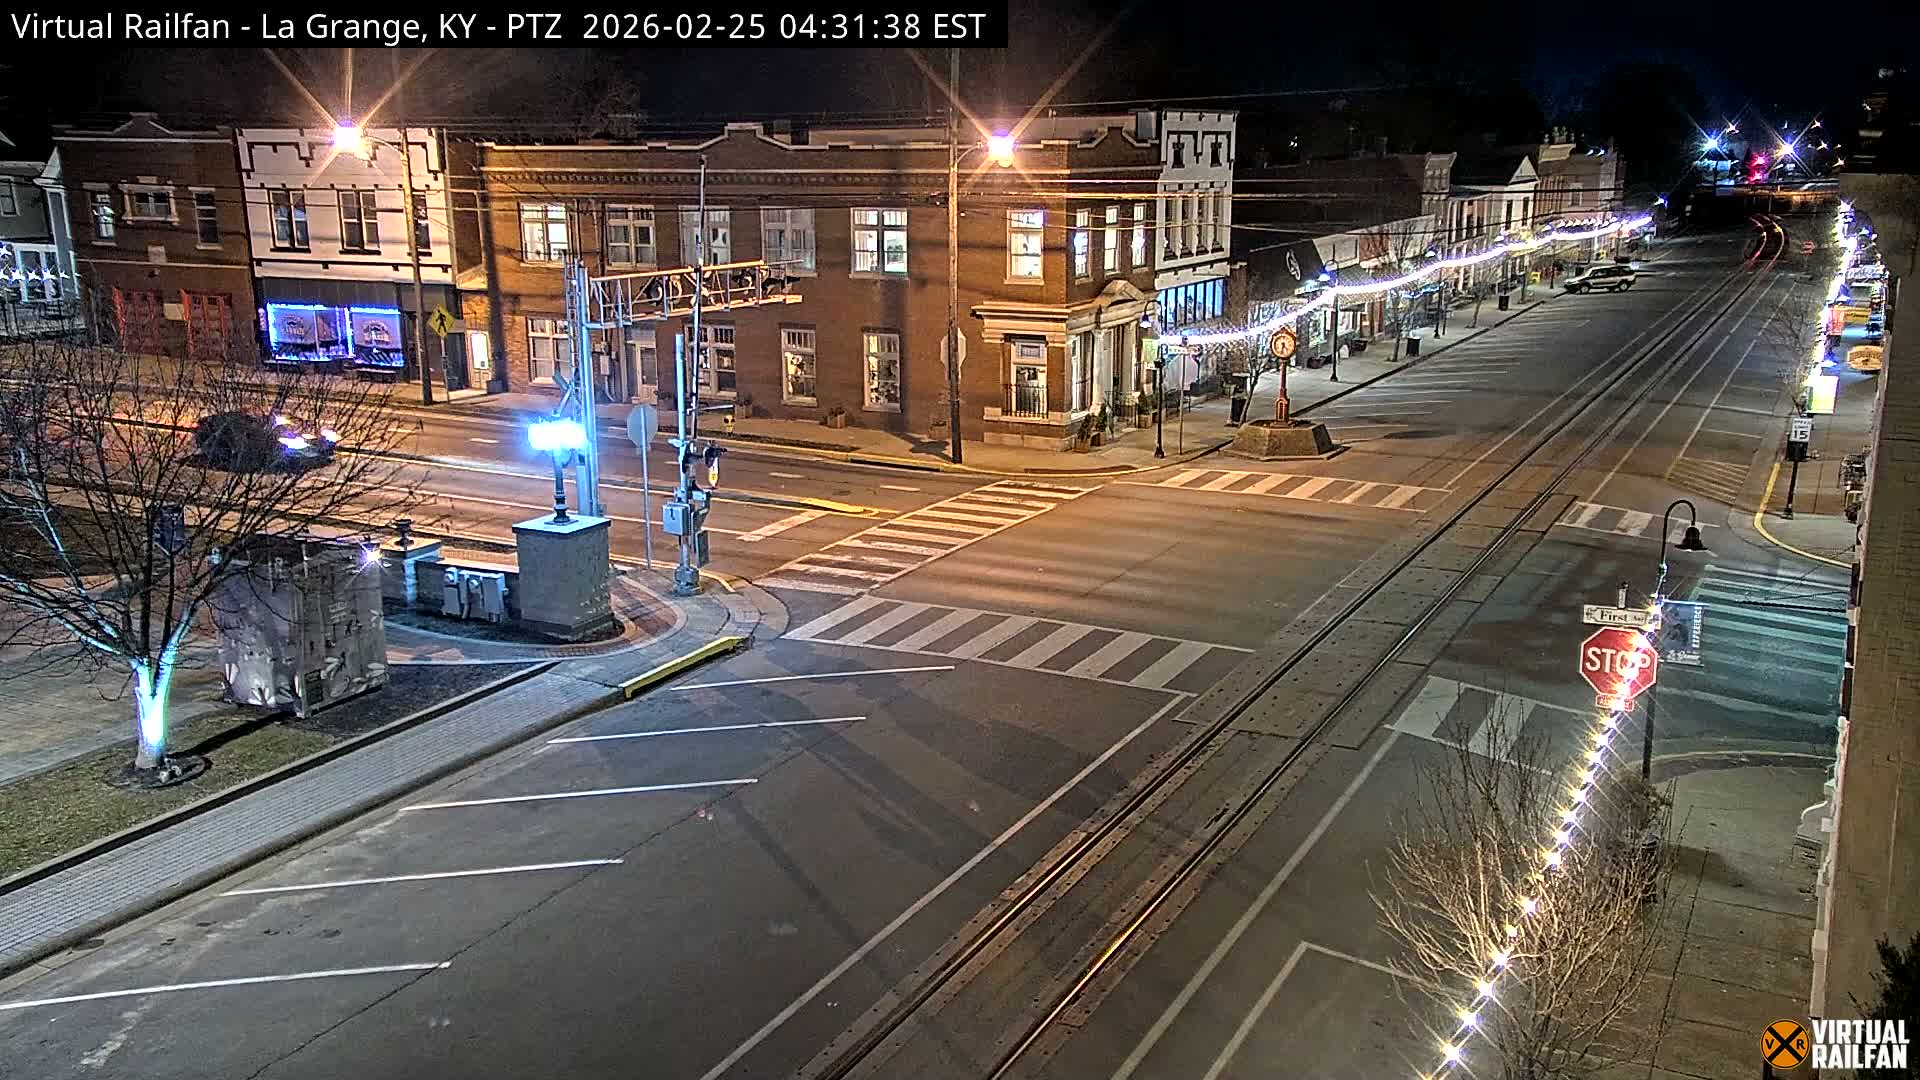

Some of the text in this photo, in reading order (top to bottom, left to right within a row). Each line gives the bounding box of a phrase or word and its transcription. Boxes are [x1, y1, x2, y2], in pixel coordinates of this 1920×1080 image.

[1794, 429, 1809, 440] 15
[1600, 610, 1628, 622] First
[1585, 646, 1651, 677] STOP
